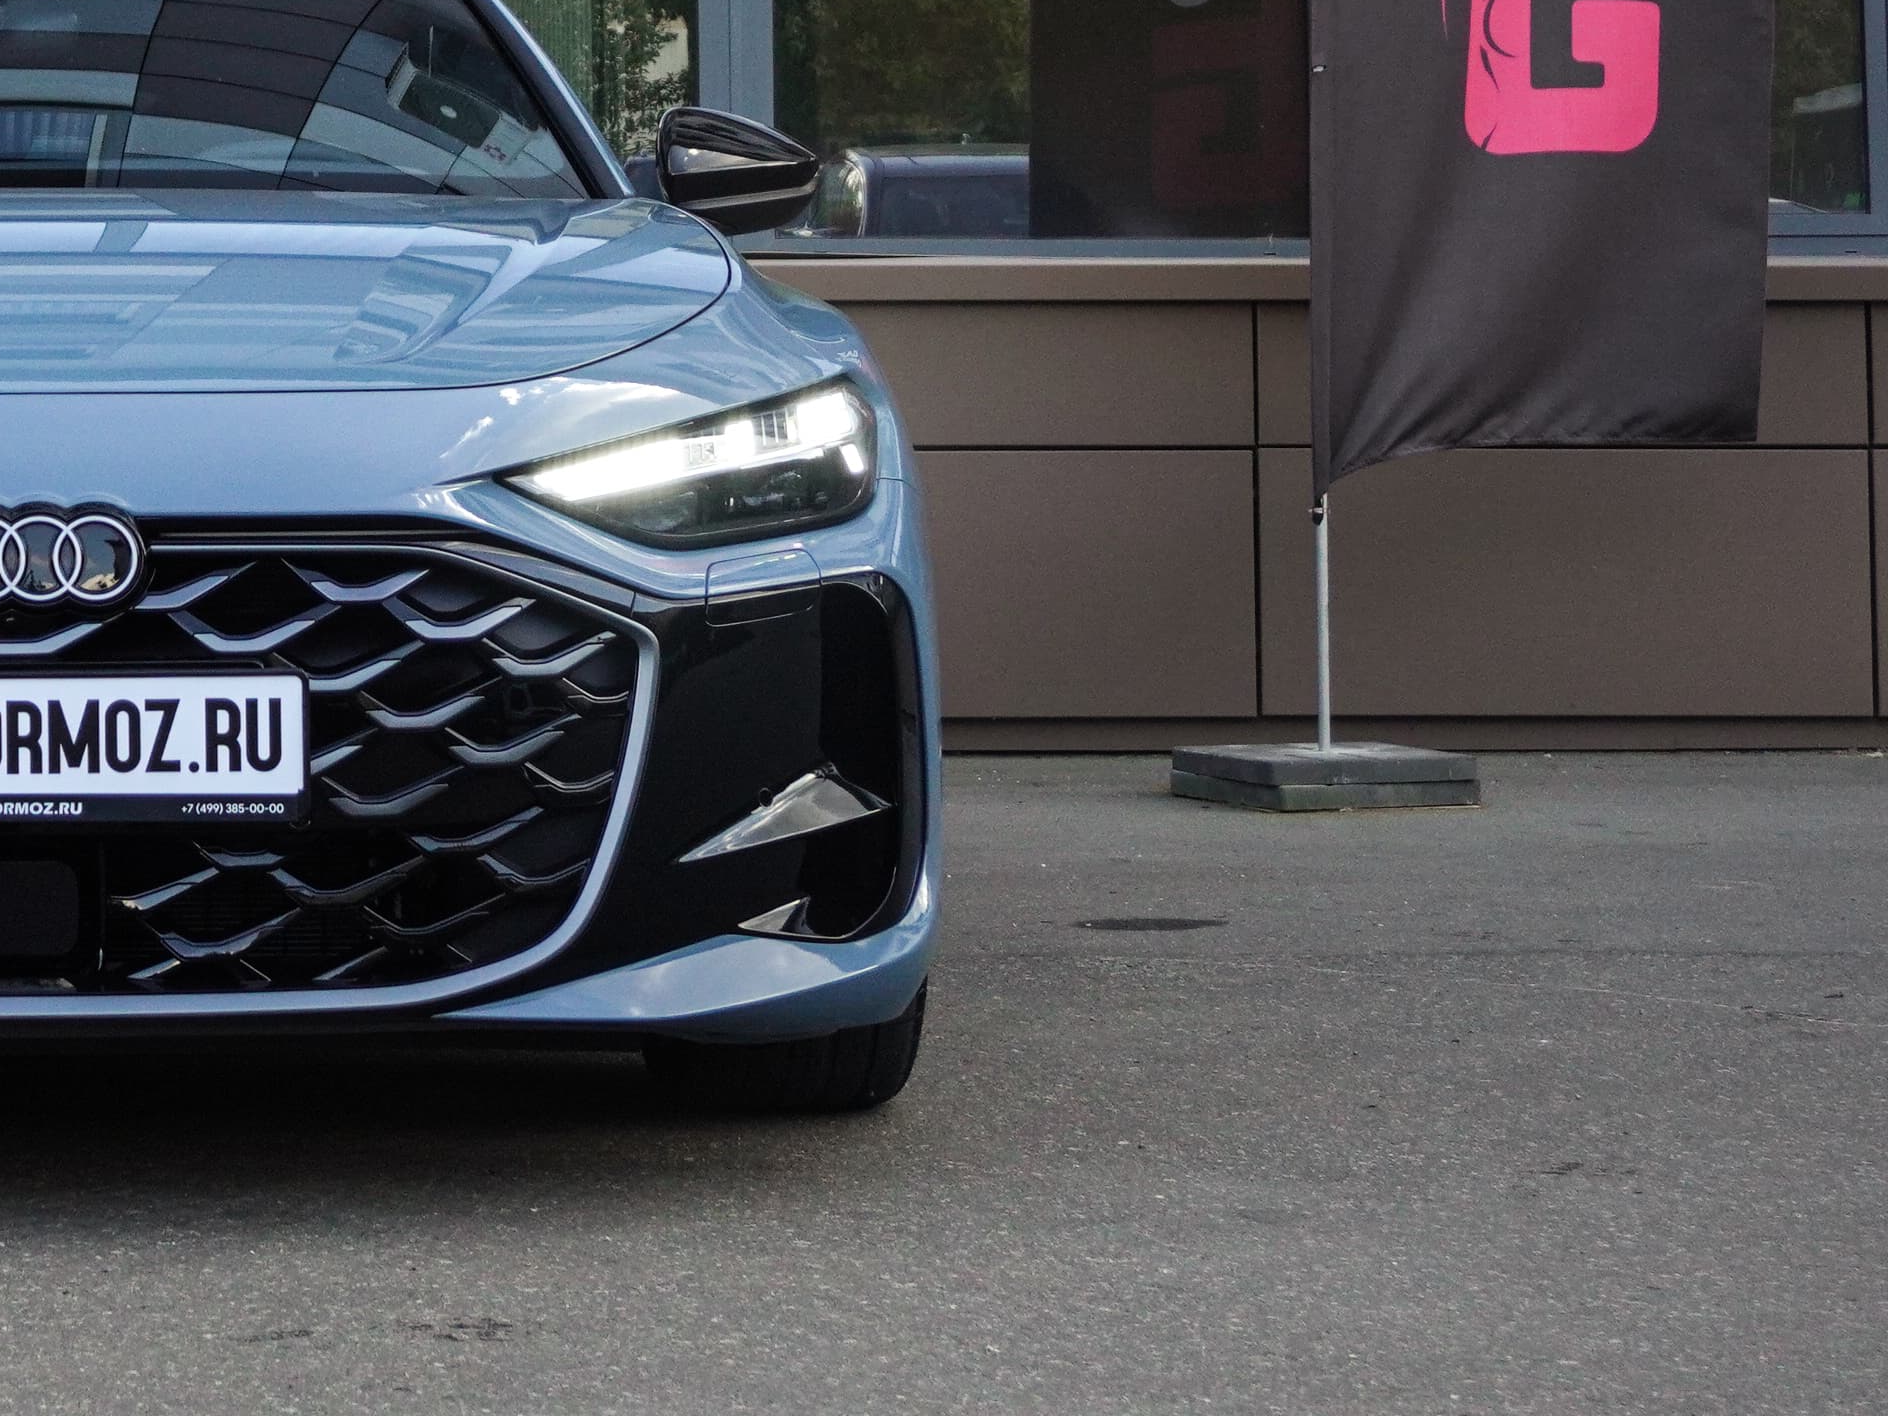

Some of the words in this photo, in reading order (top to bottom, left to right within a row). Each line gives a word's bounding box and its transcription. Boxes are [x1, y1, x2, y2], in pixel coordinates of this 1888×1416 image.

[181, 802, 194, 814] +7
[195, 802, 224, 815] (499)
[225, 802, 285, 814] 385-00-00
